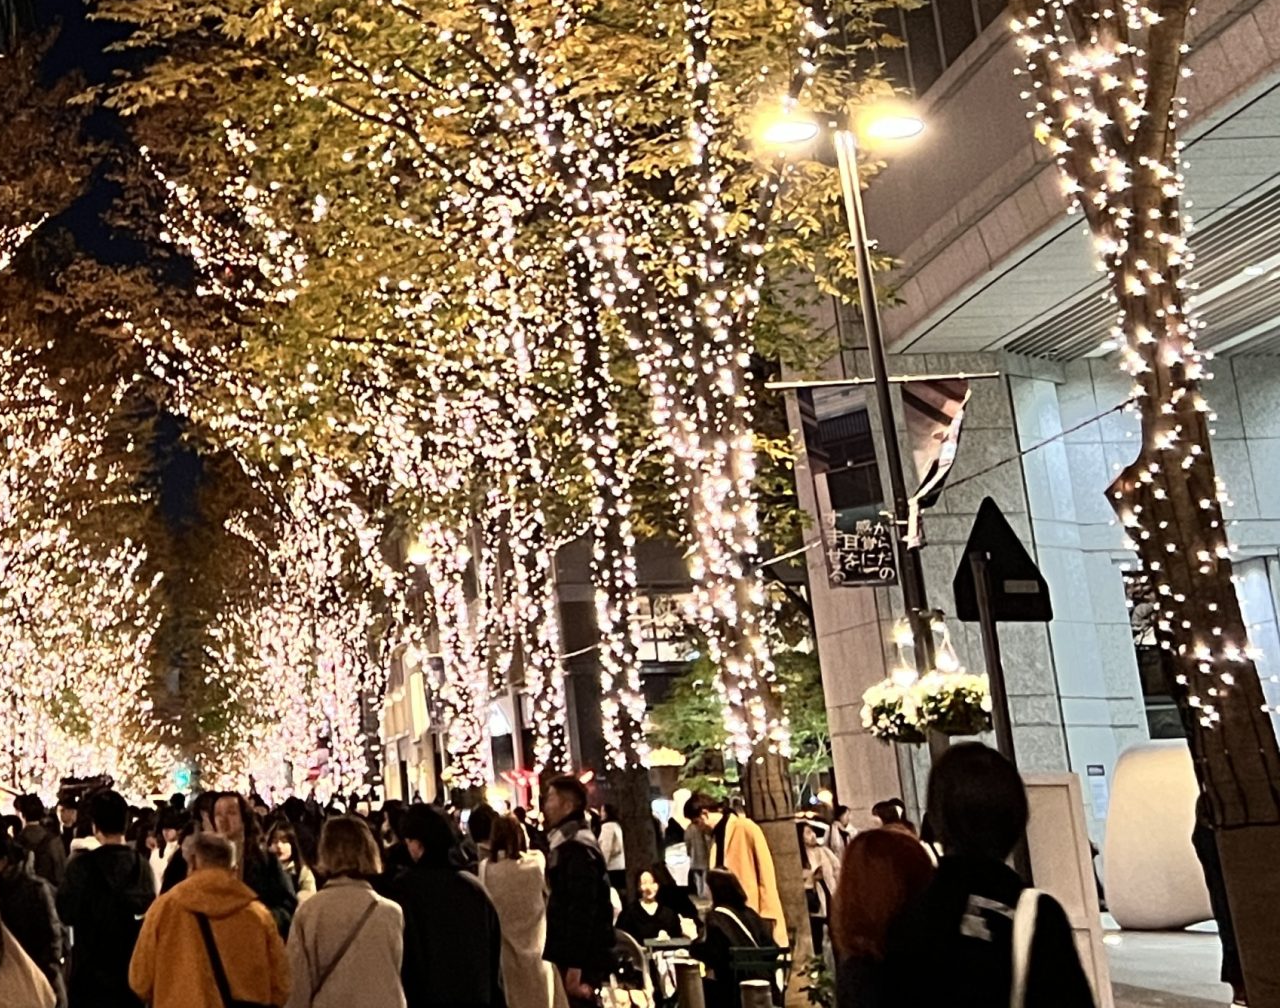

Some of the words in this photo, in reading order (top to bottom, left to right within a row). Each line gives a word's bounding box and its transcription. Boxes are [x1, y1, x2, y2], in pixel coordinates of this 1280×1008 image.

[823, 509, 846, 583] すませる
[873, 521, 895, 580] からだの
